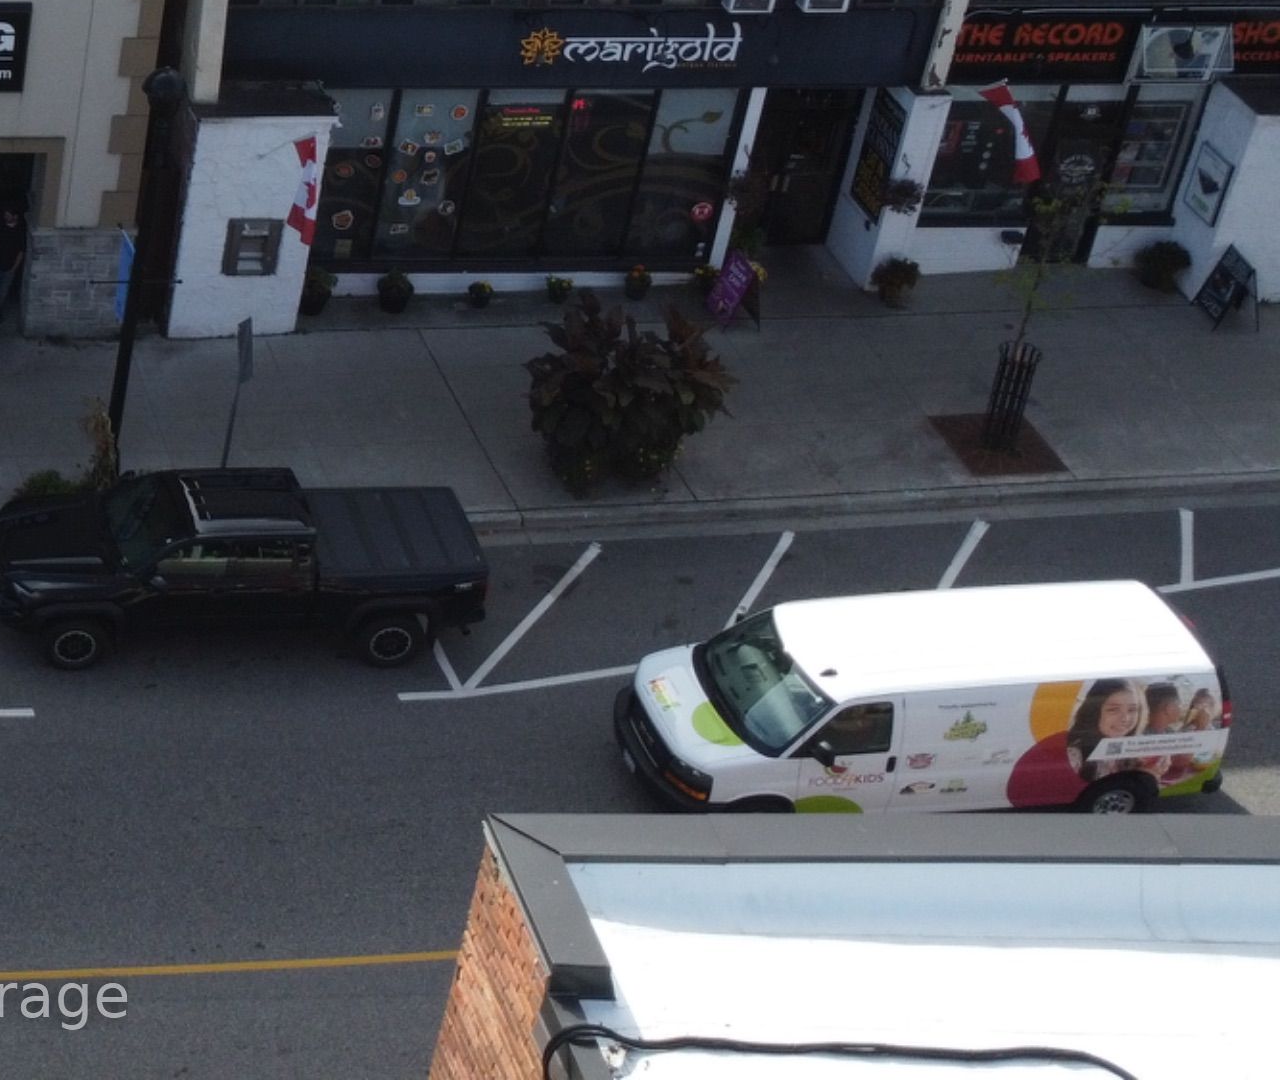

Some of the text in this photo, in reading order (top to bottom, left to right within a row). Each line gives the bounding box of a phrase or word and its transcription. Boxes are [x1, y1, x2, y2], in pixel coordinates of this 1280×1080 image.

[956, 23, 1007, 46] THE
[1013, 22, 1125, 46] RECORD
[563, 22, 743, 72] marigold
[1047, 51, 1118, 63] SPEAKERS
